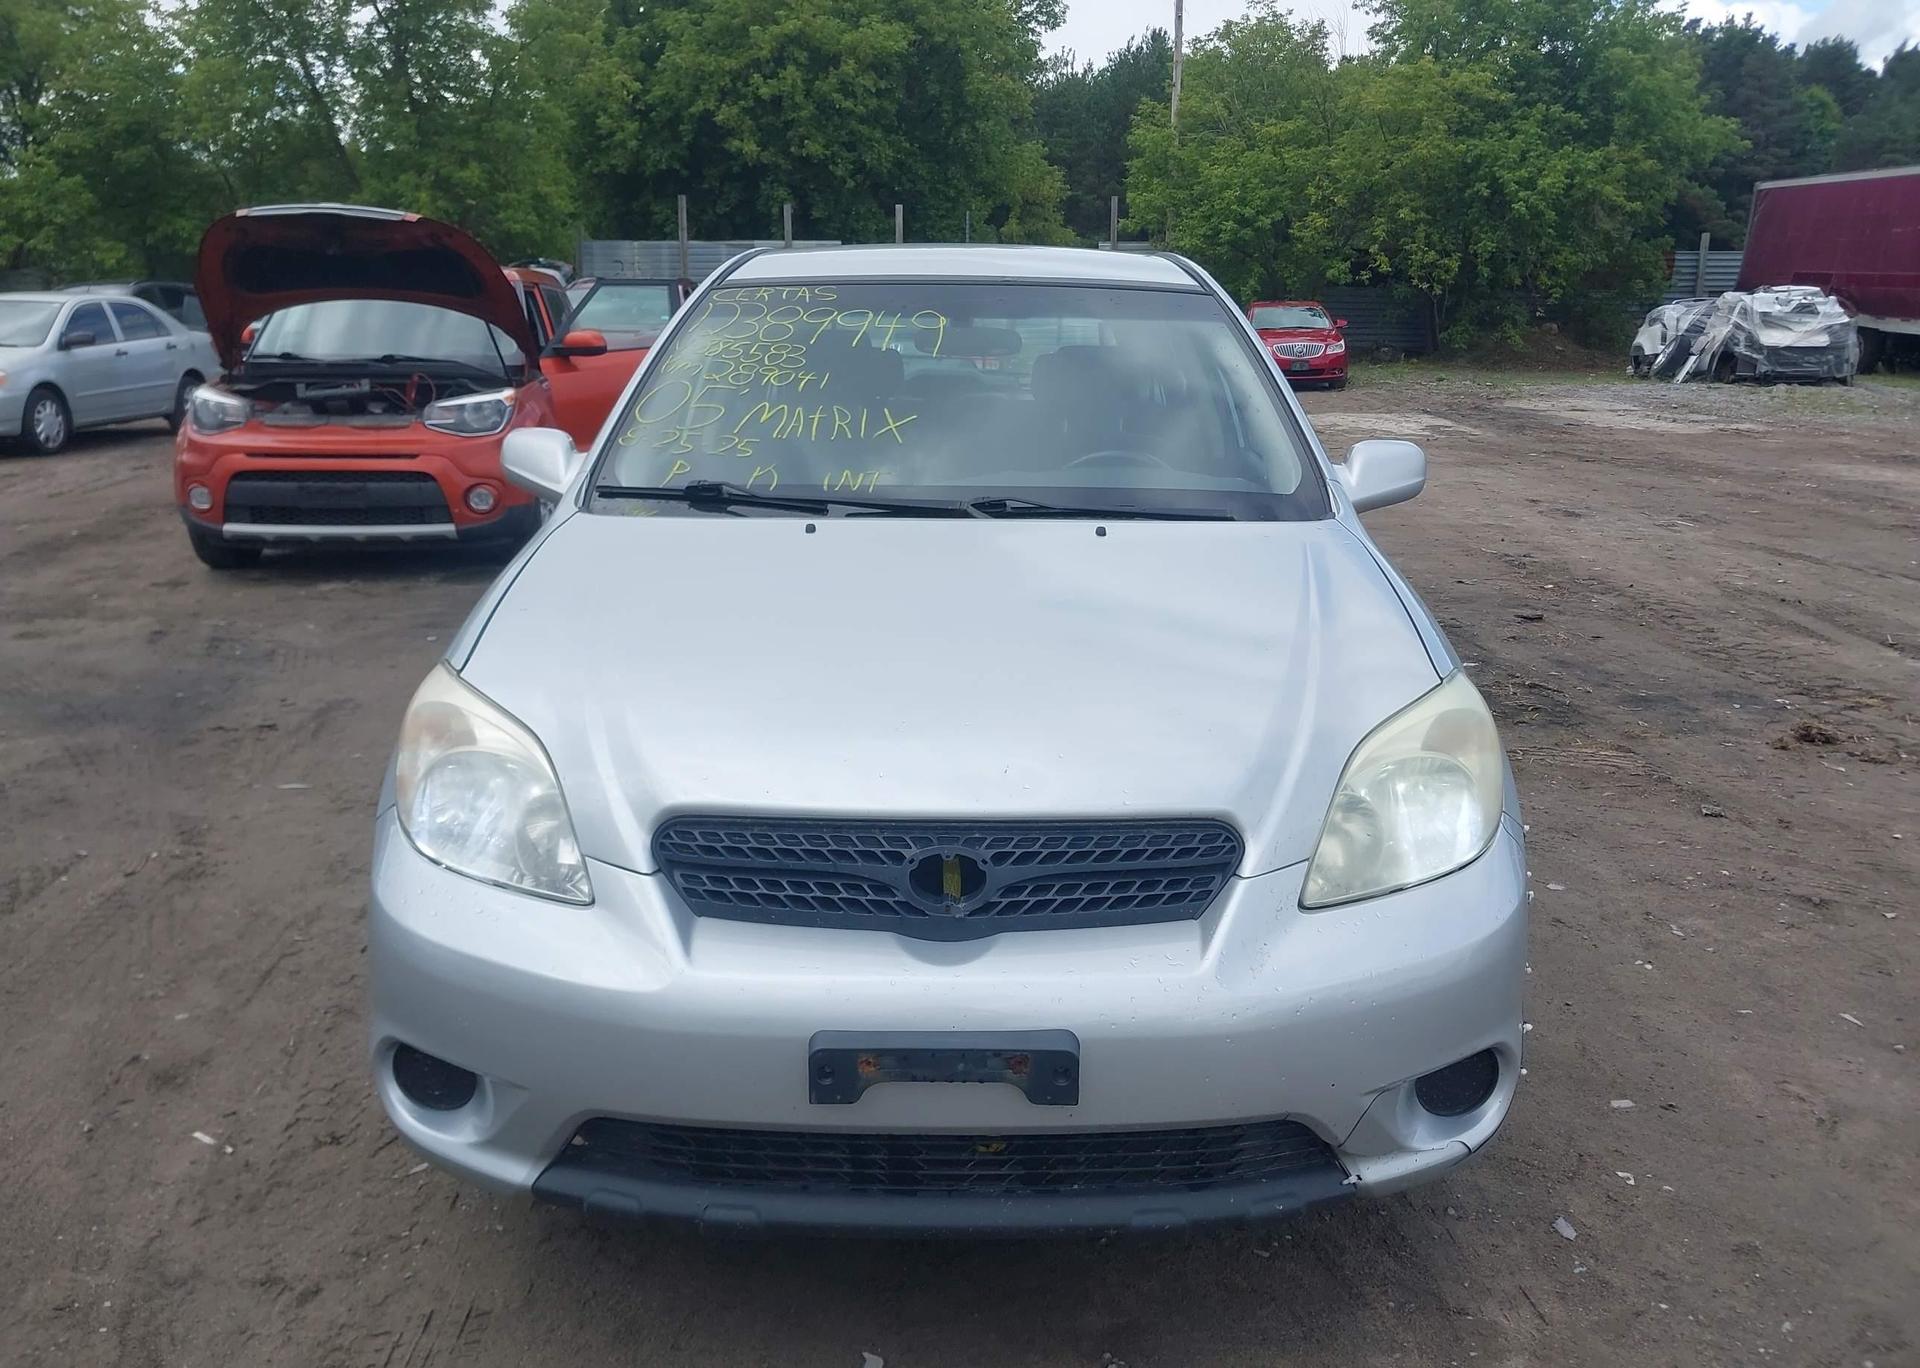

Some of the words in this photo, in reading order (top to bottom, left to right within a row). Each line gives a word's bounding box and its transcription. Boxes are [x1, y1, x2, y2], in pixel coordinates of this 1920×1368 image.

[713, 286, 839, 303] CERTAS
[704, 359, 830, 392] 289041
[658, 459, 691, 488] P
